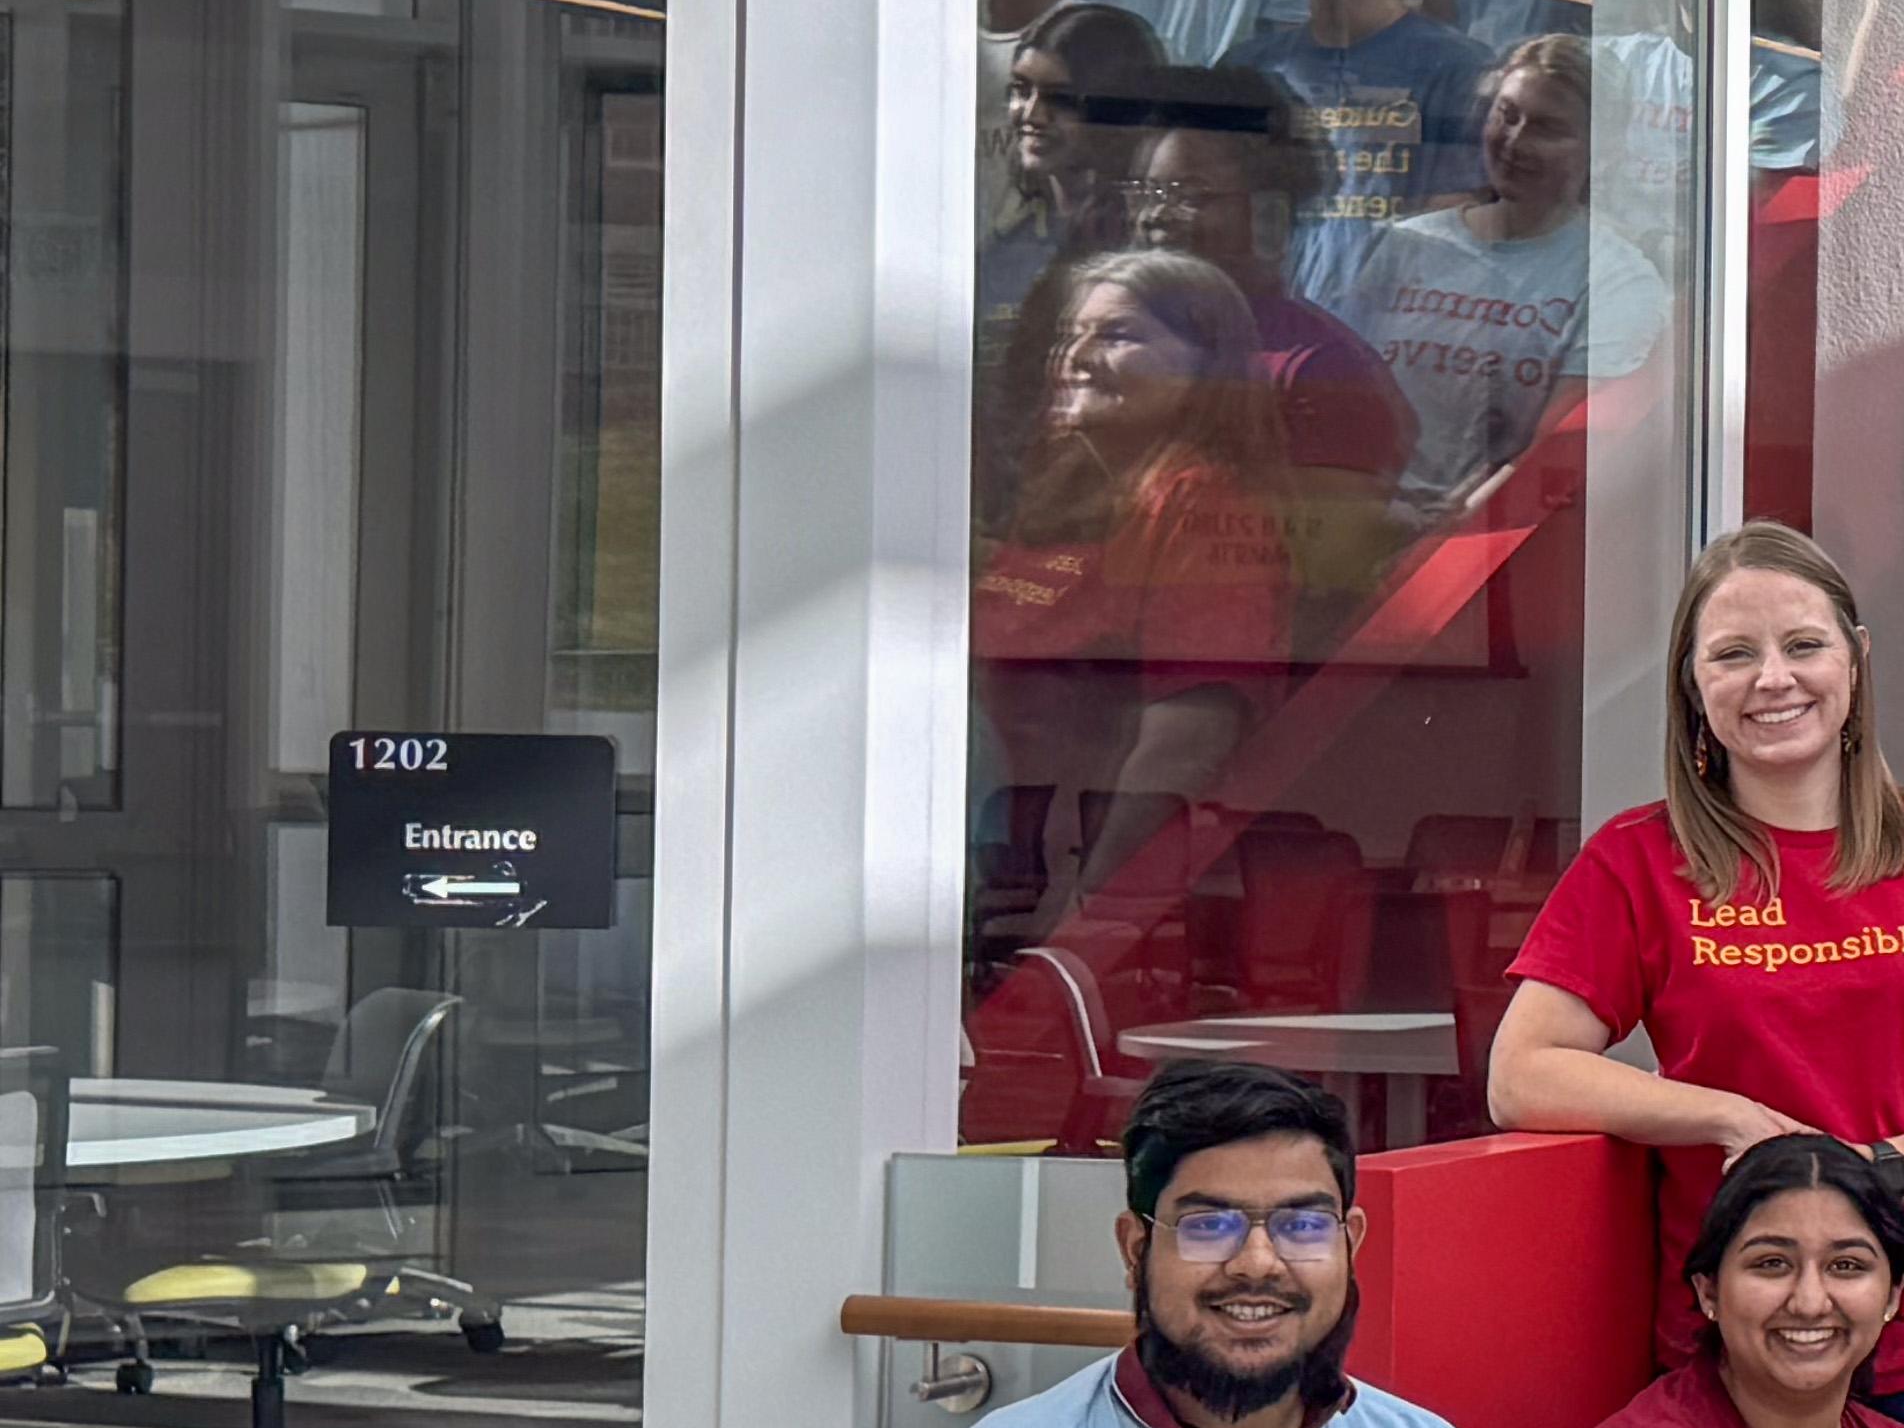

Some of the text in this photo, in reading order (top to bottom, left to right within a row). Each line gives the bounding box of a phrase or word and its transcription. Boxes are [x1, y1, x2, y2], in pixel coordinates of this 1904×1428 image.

[349, 738, 448, 771] 1202
[405, 822, 537, 851] Entrance
[1689, 898, 1786, 927] Lead
